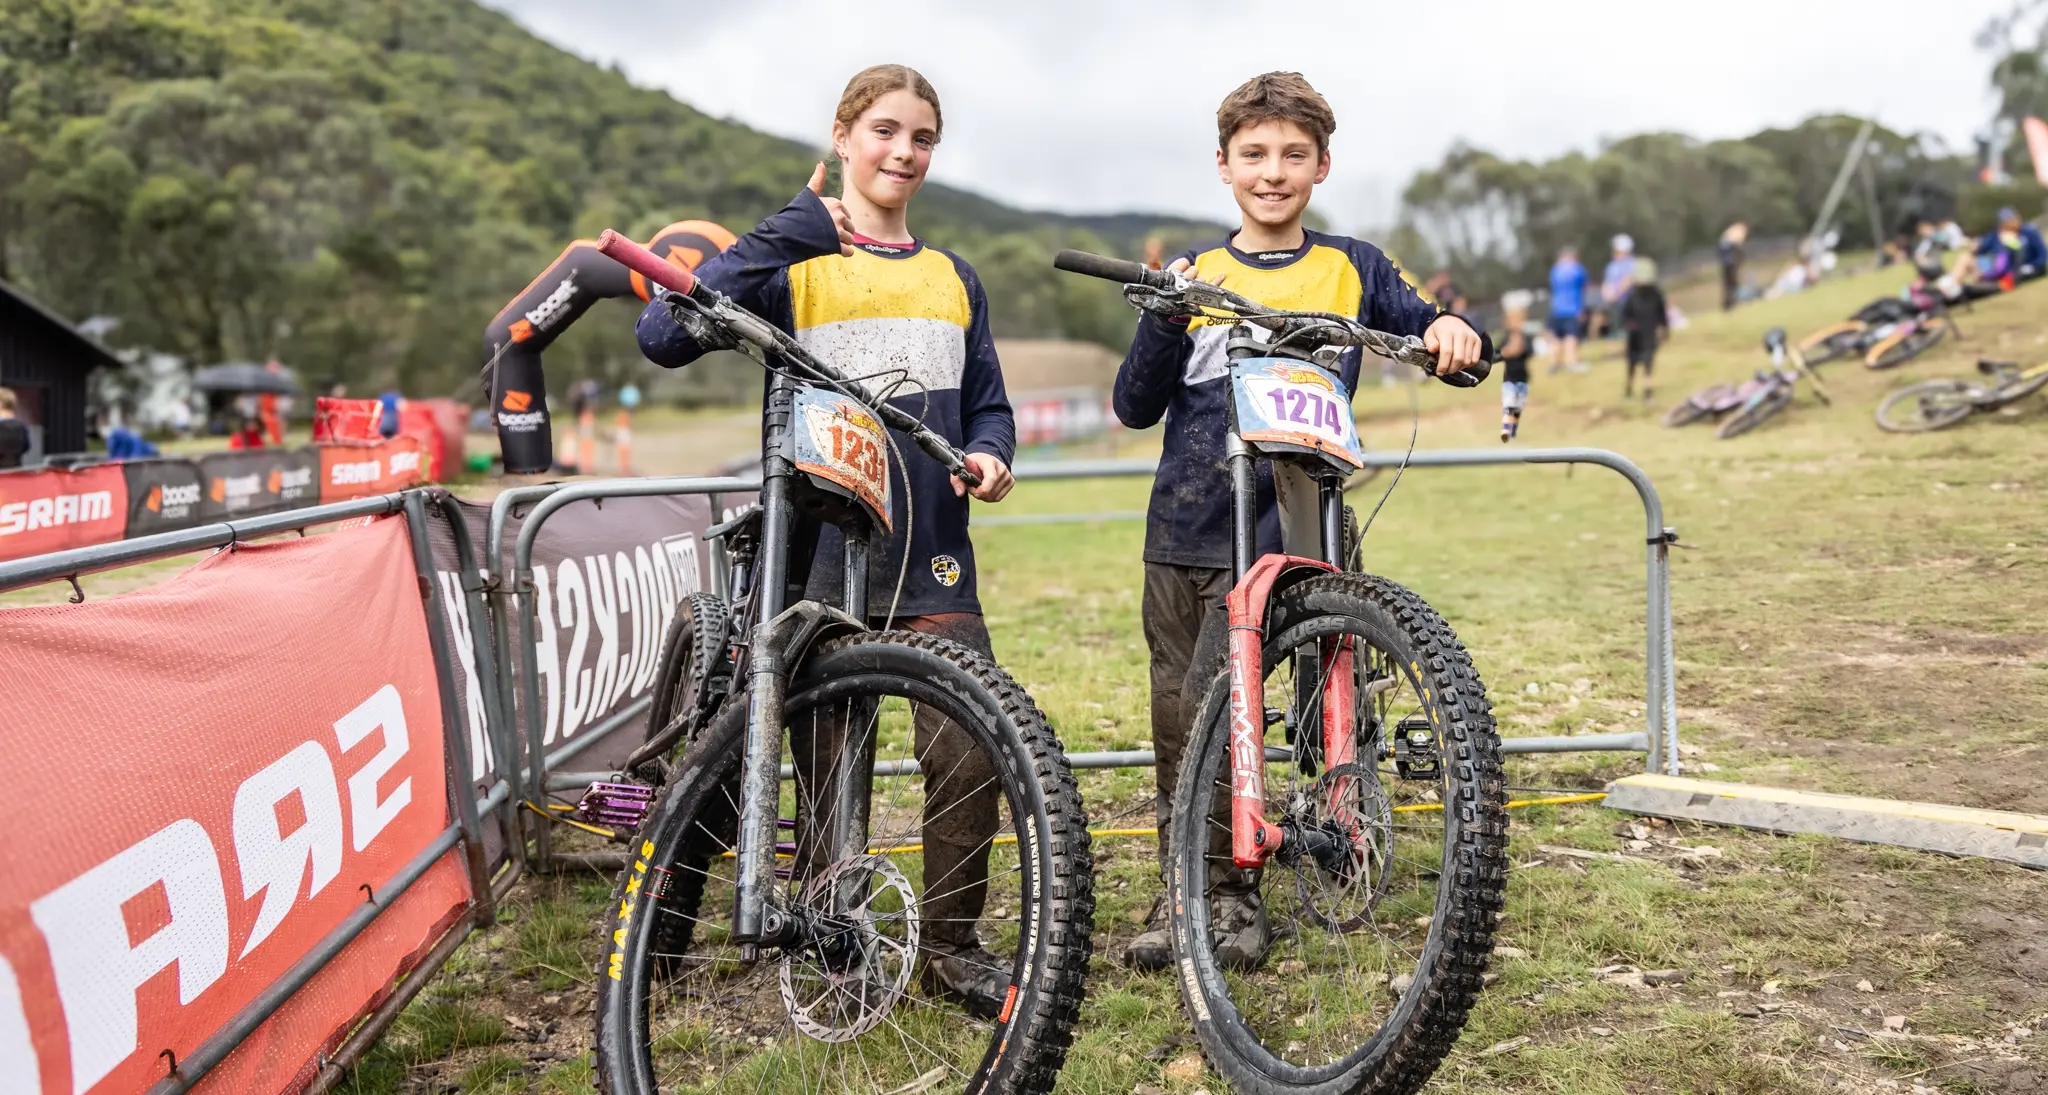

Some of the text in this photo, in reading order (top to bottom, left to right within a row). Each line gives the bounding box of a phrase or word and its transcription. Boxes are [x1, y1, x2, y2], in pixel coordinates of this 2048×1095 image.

[525, 279, 579, 326] boost
[497, 410, 546, 426] boost
[1267, 388, 1342, 437] 1274
[161, 483, 200, 506] boost
[331, 459, 382, 485] SRAM
[0, 490, 113, 537] SRAM
[1026, 814, 1041, 899] MINION
[608, 838, 655, 982] MAXXIS
